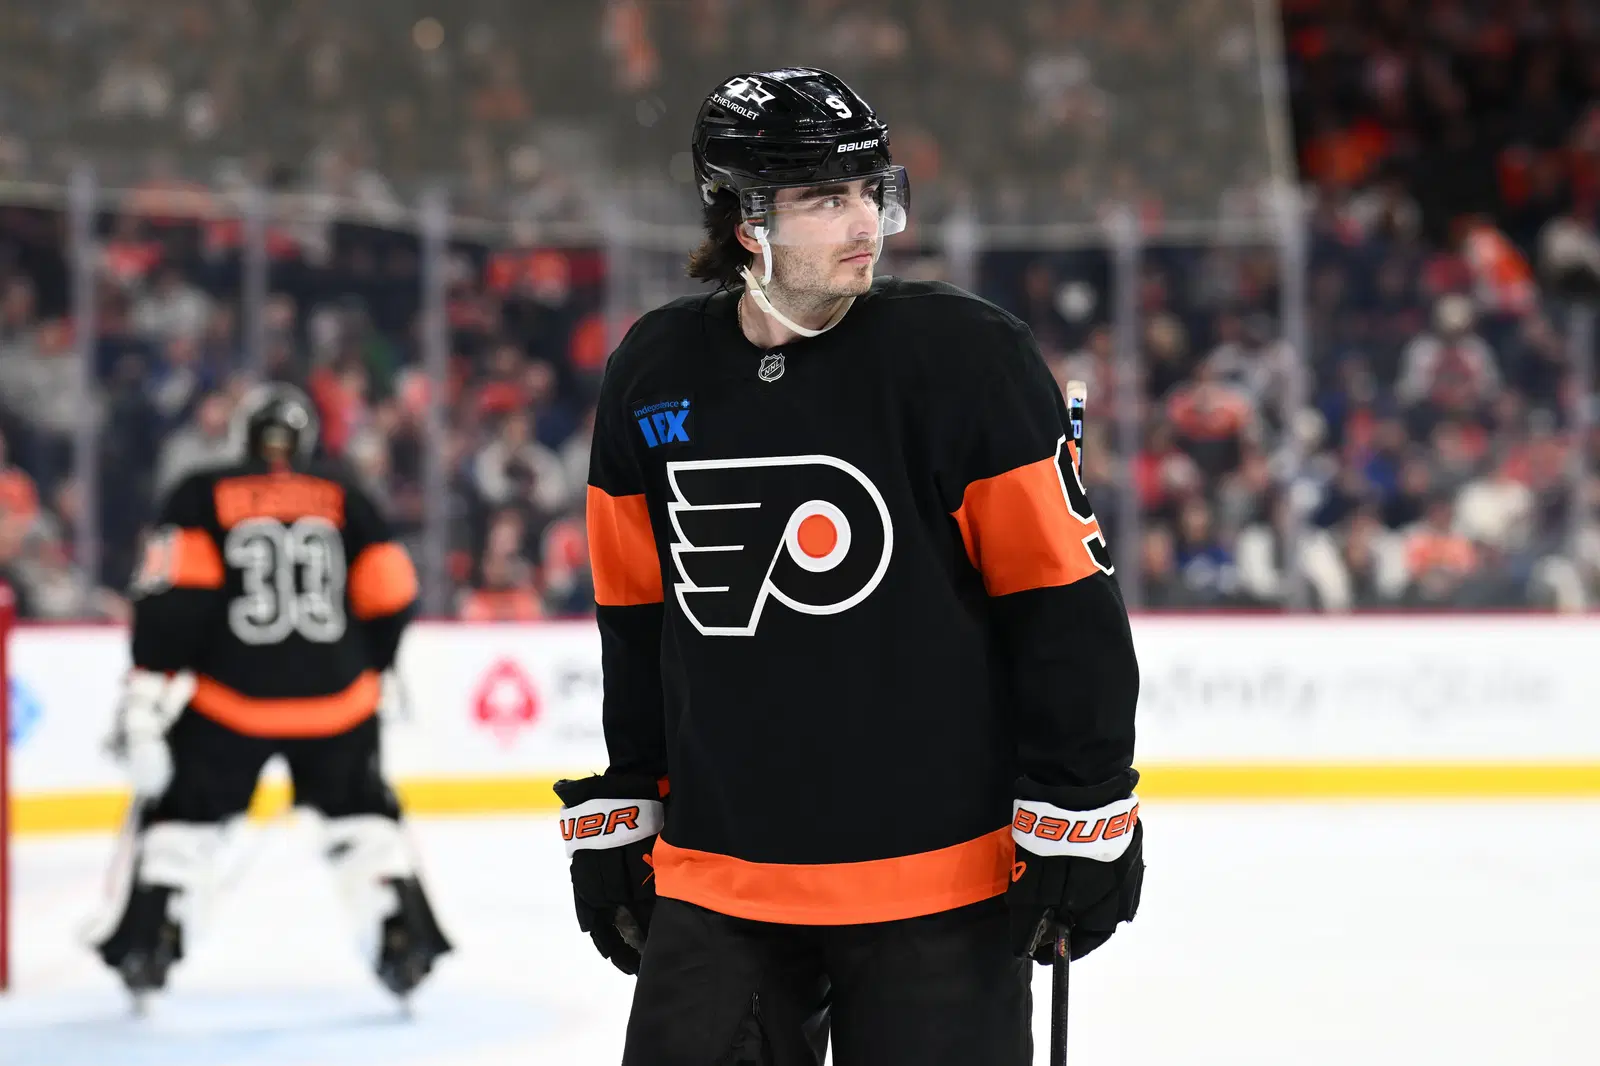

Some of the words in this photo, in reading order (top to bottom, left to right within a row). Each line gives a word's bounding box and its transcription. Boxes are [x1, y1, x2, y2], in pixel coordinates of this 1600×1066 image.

[710, 93, 760, 121] CHEVROLET
[825, 96, 852, 119] 9
[837, 138, 879, 153] BAUER
[634, 400, 679, 418] Indepeence
[223, 514, 348, 646] 33
[560, 805, 640, 841] UER
[1013, 803, 1140, 843] BAUER
